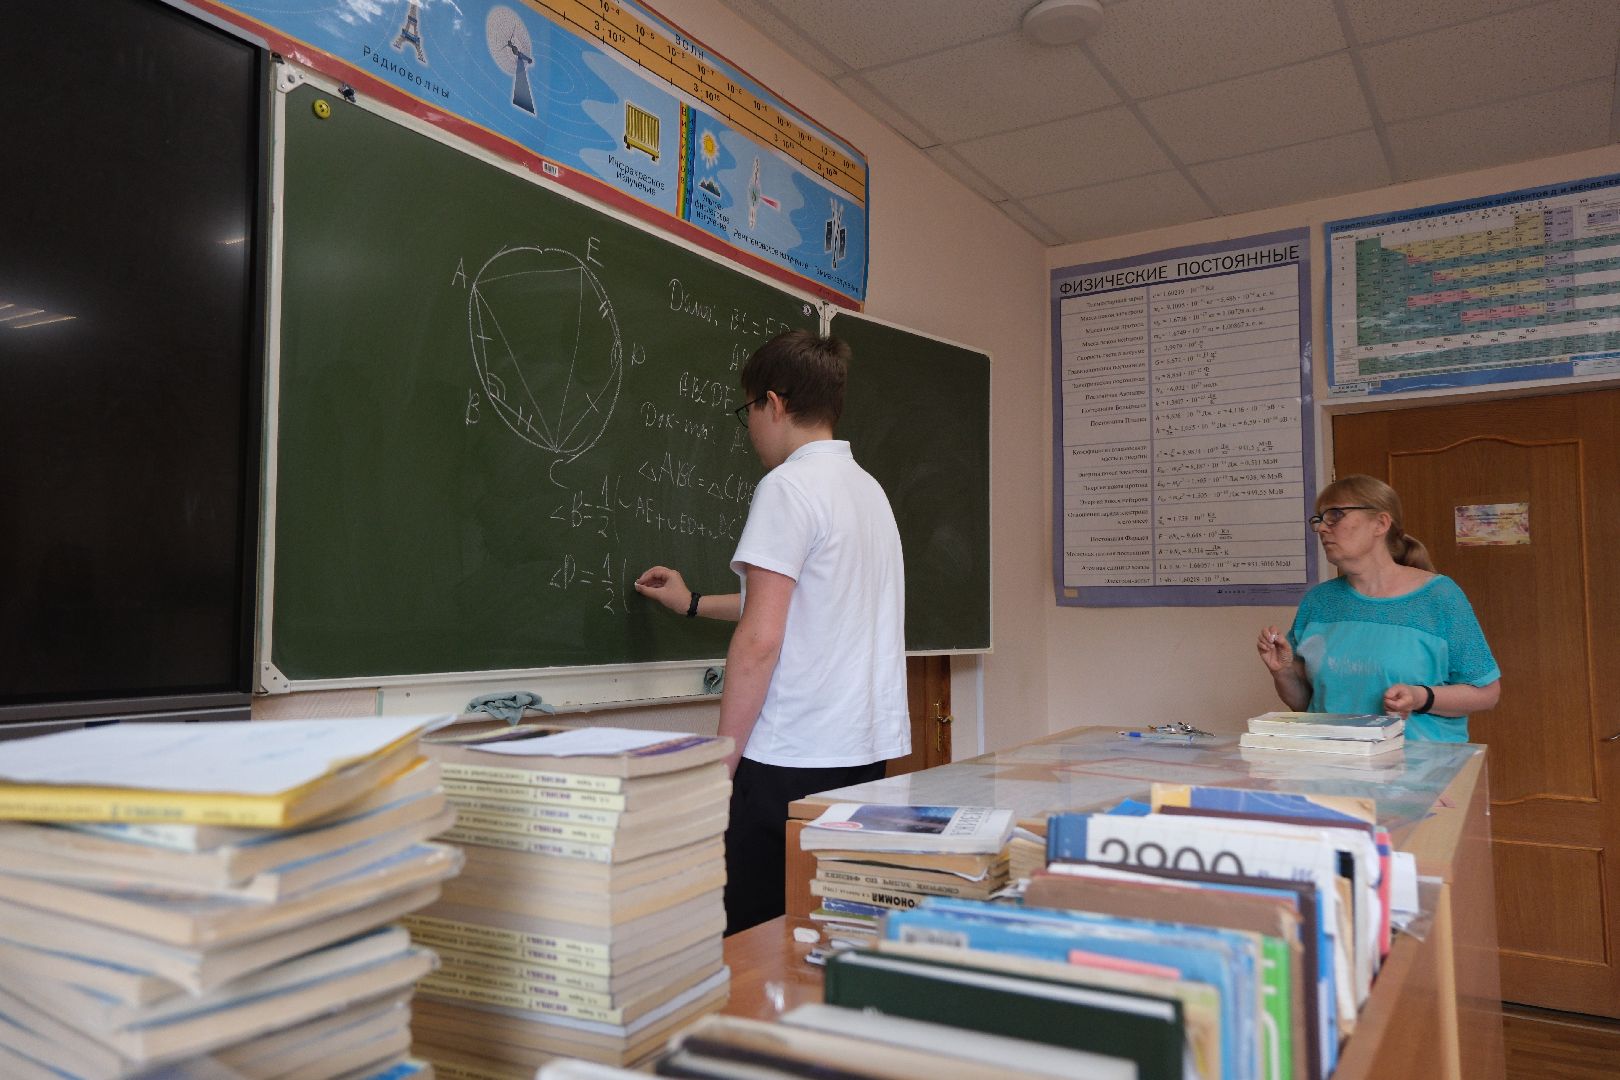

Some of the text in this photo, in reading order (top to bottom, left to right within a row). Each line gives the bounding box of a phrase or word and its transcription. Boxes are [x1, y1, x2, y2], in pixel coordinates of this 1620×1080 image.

[363, 45, 450, 99] Радиоволны
[1060, 245, 1300, 295] ФИЗИЧЕСКИЕ ПОСТОЯННЫЕ
[871, 892, 916, 908] ОНОМИЯ
